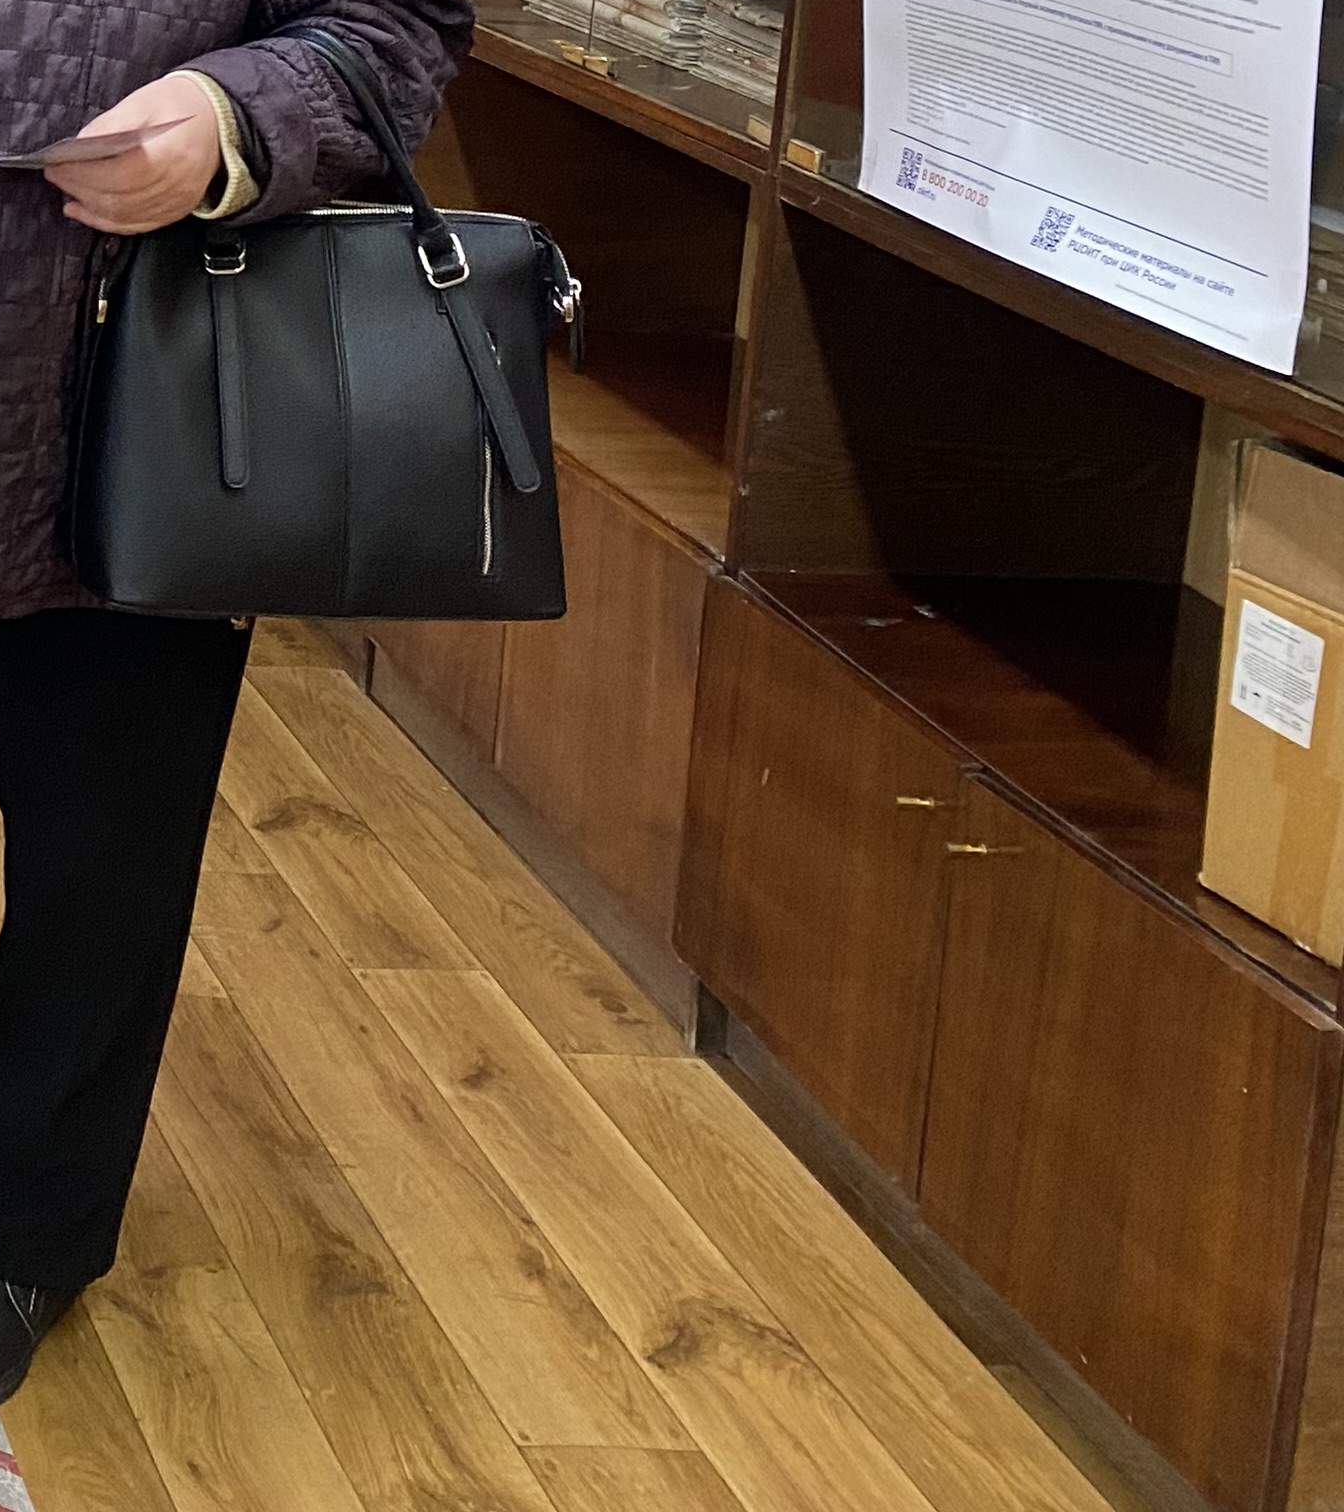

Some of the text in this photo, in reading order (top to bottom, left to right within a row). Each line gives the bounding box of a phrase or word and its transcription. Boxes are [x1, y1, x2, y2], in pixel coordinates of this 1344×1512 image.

[1068, 239, 1177, 291] РЦОИТ при ЦИК России
[1074, 225, 1235, 297] Методические материалы на сайте
